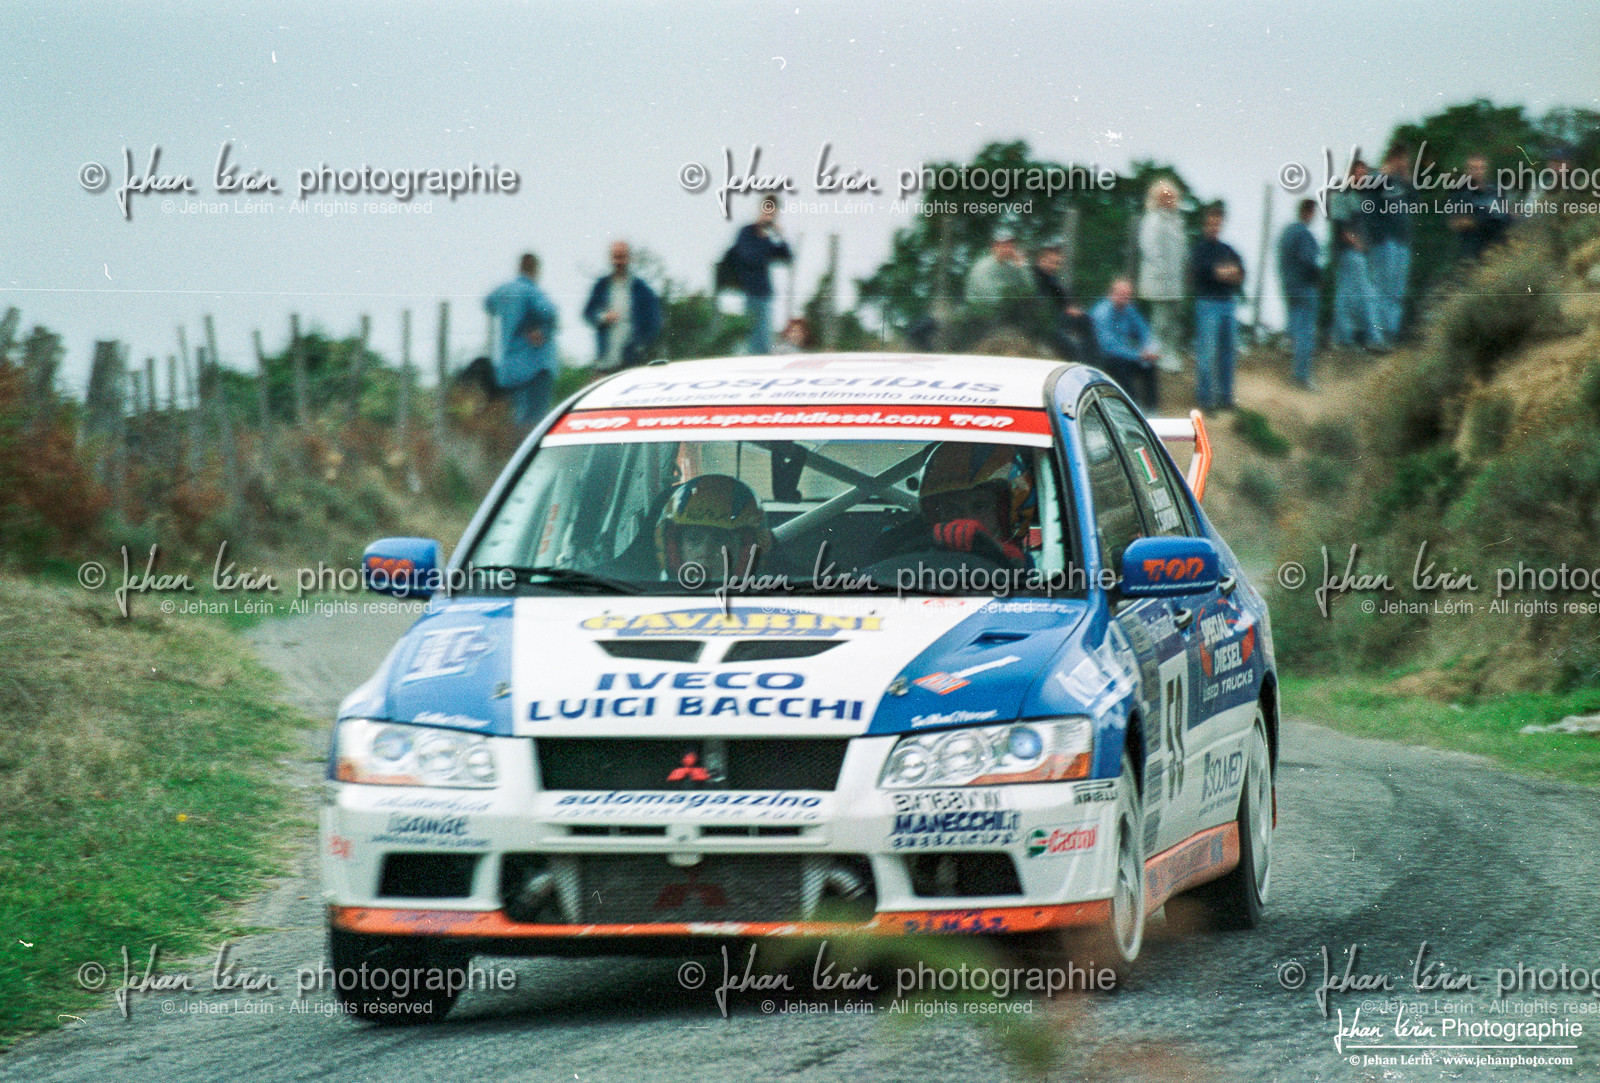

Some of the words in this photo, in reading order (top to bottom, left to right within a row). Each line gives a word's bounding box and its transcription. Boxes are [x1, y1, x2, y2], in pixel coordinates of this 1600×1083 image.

[619, 376, 1004, 396] prosperibus
[909, 394, 998, 406] autobus
[636, 411, 942, 428] www.specialdiesel.com
[580, 611, 884, 631] GAVARINI
[1214, 641, 1243, 676] DIESEL
[595, 672, 805, 692] IVECO
[1221, 667, 1253, 696] TRUCKS
[528, 697, 658, 721] LUIGI
[675, 697, 864, 721] BACCHI
[555, 788, 822, 809] automagazzino
